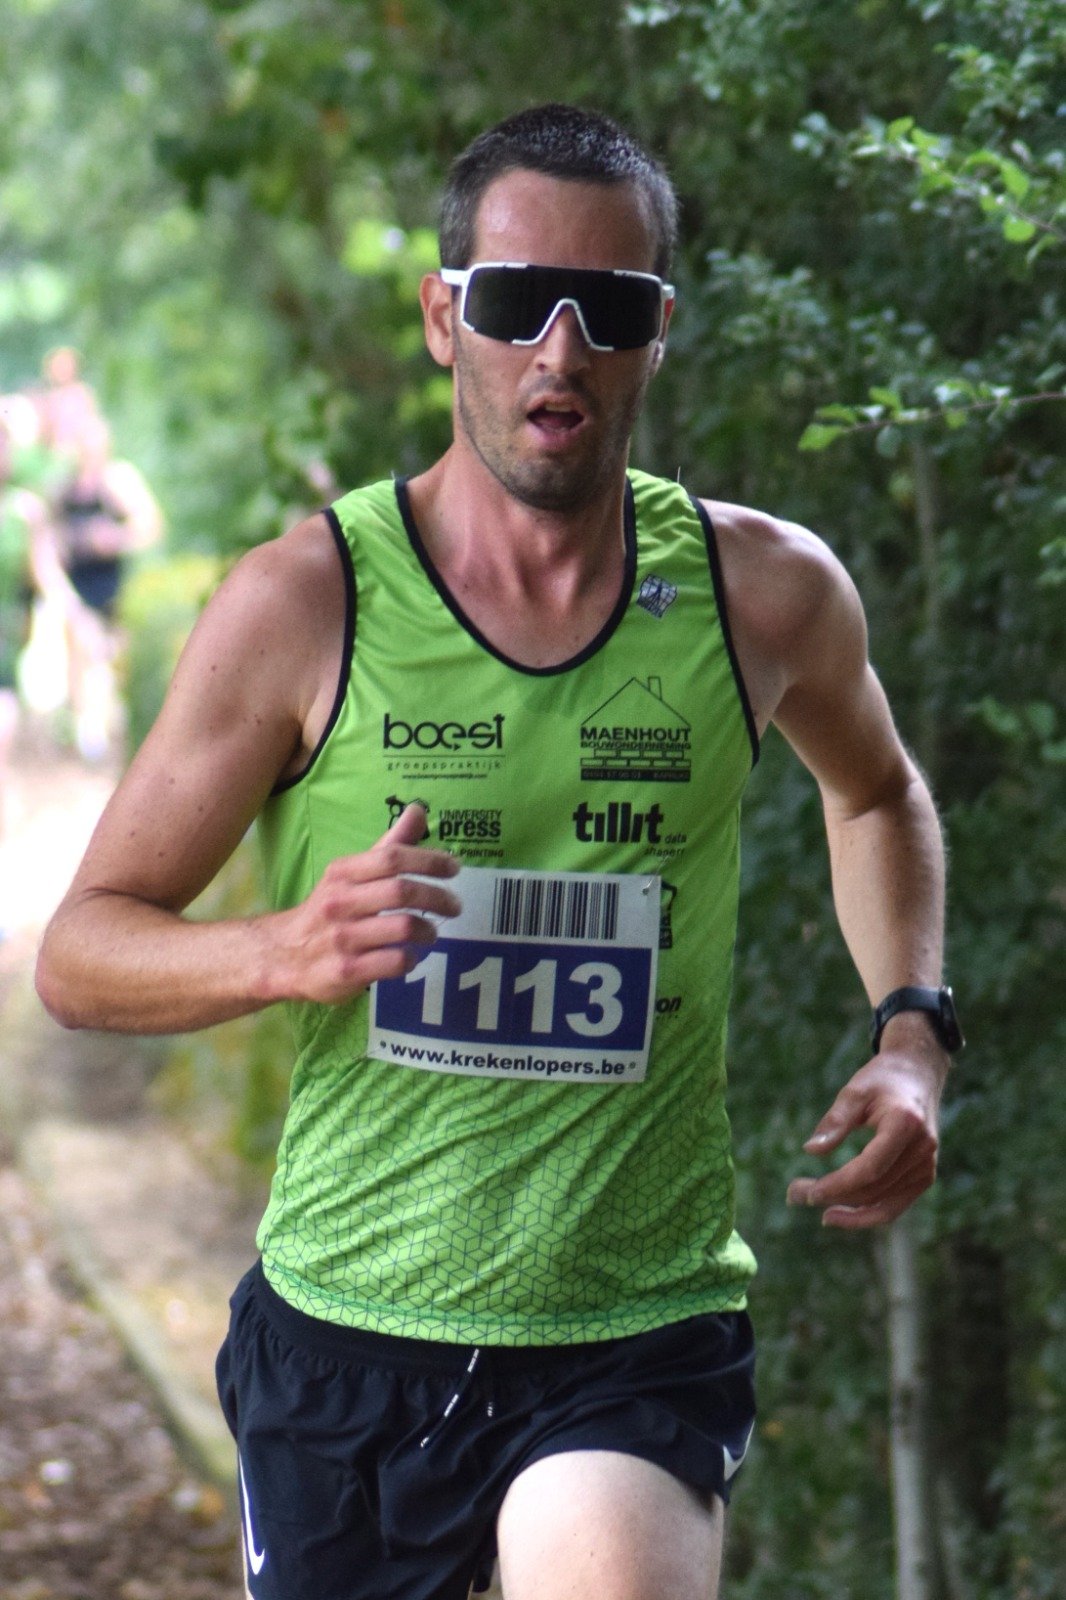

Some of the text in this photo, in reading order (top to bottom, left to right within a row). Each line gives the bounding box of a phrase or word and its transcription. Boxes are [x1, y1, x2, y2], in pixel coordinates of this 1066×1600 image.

[580, 727, 692, 741] MAENHOUT
[387, 762, 501, 771] groepspraktijk
[438, 809, 503, 820] UNIVERSITY
[572, 802, 664, 844] tillit
[438, 818, 502, 841] press
[460, 848, 504, 858] PRINTING
[405, 951, 624, 1037] 1113
[390, 1042, 626, 1076] www.krekenlopers.be
